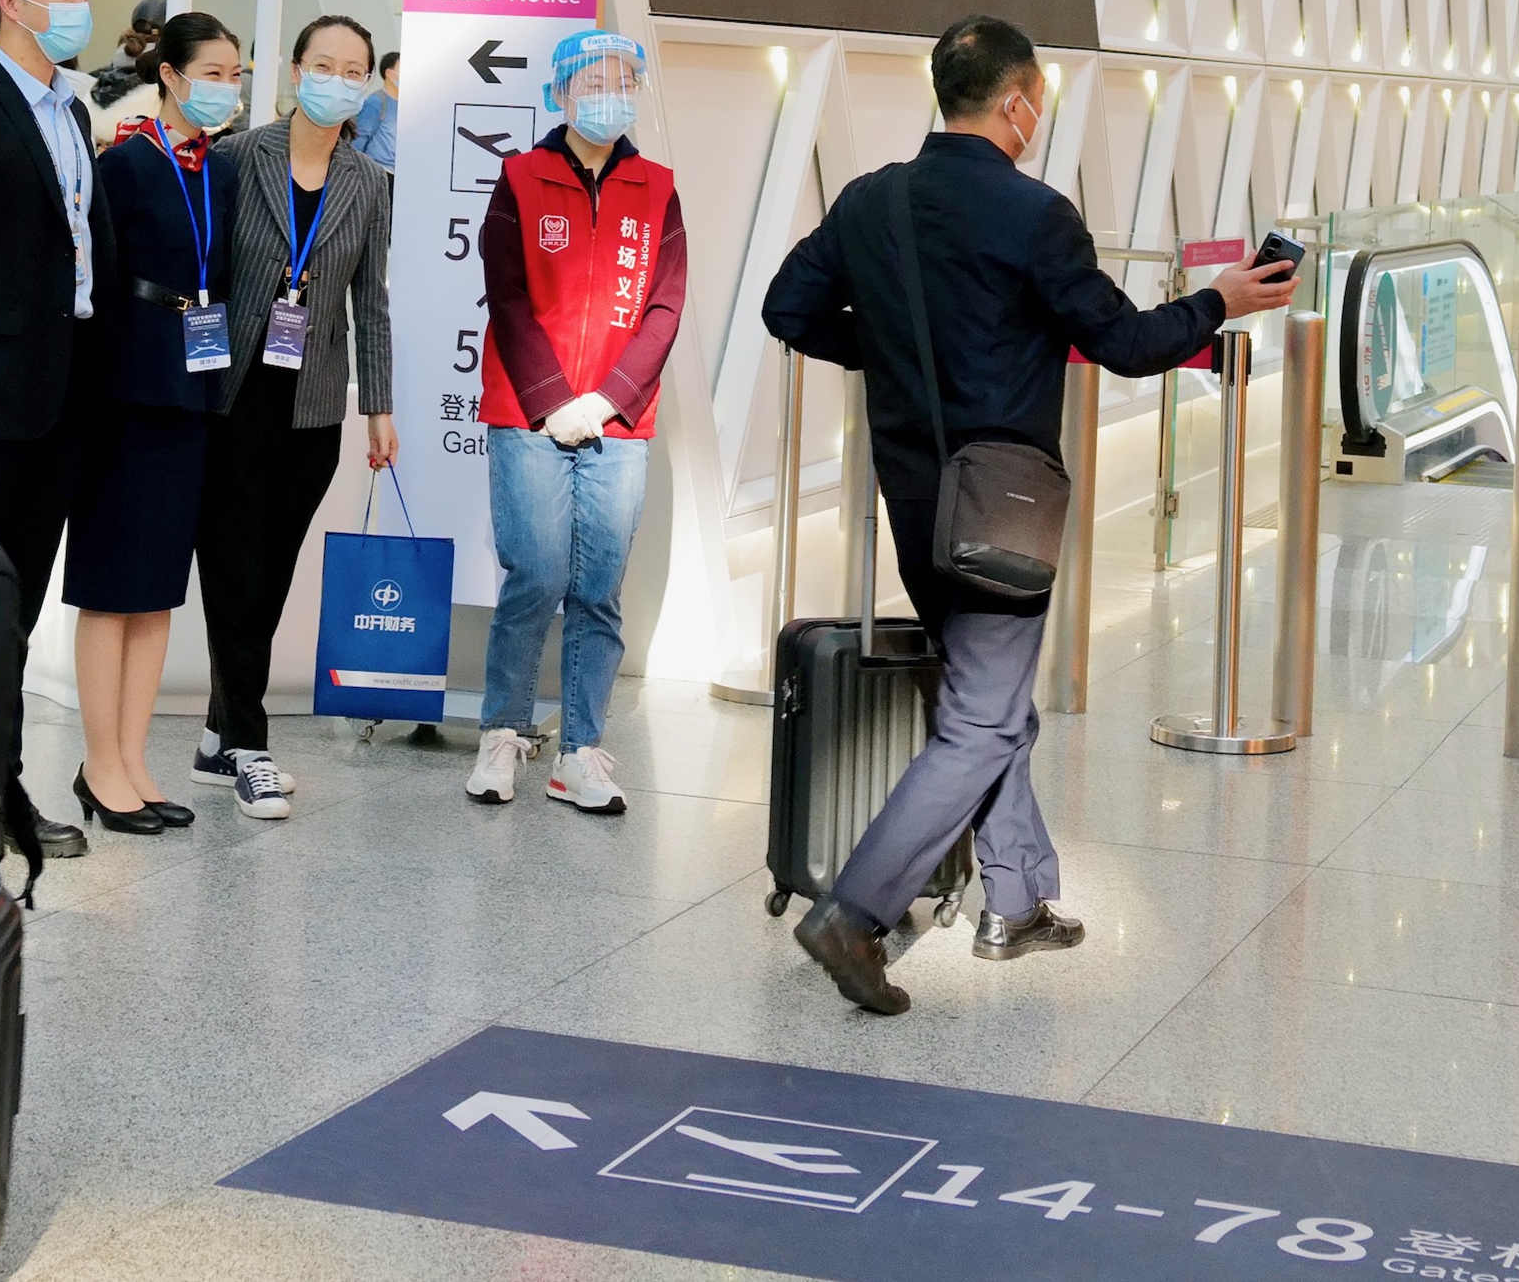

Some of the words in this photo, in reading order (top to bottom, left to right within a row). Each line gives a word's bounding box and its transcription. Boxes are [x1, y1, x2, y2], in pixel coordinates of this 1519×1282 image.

[444, 217, 485, 261] 5
[640, 222, 652, 268] AIRPORT
[609, 216, 638, 329] 机场义工
[453, 329, 479, 374] 5
[354, 614, 416, 633] 中开财务
[901, 1163, 1376, 1263] 14-78
